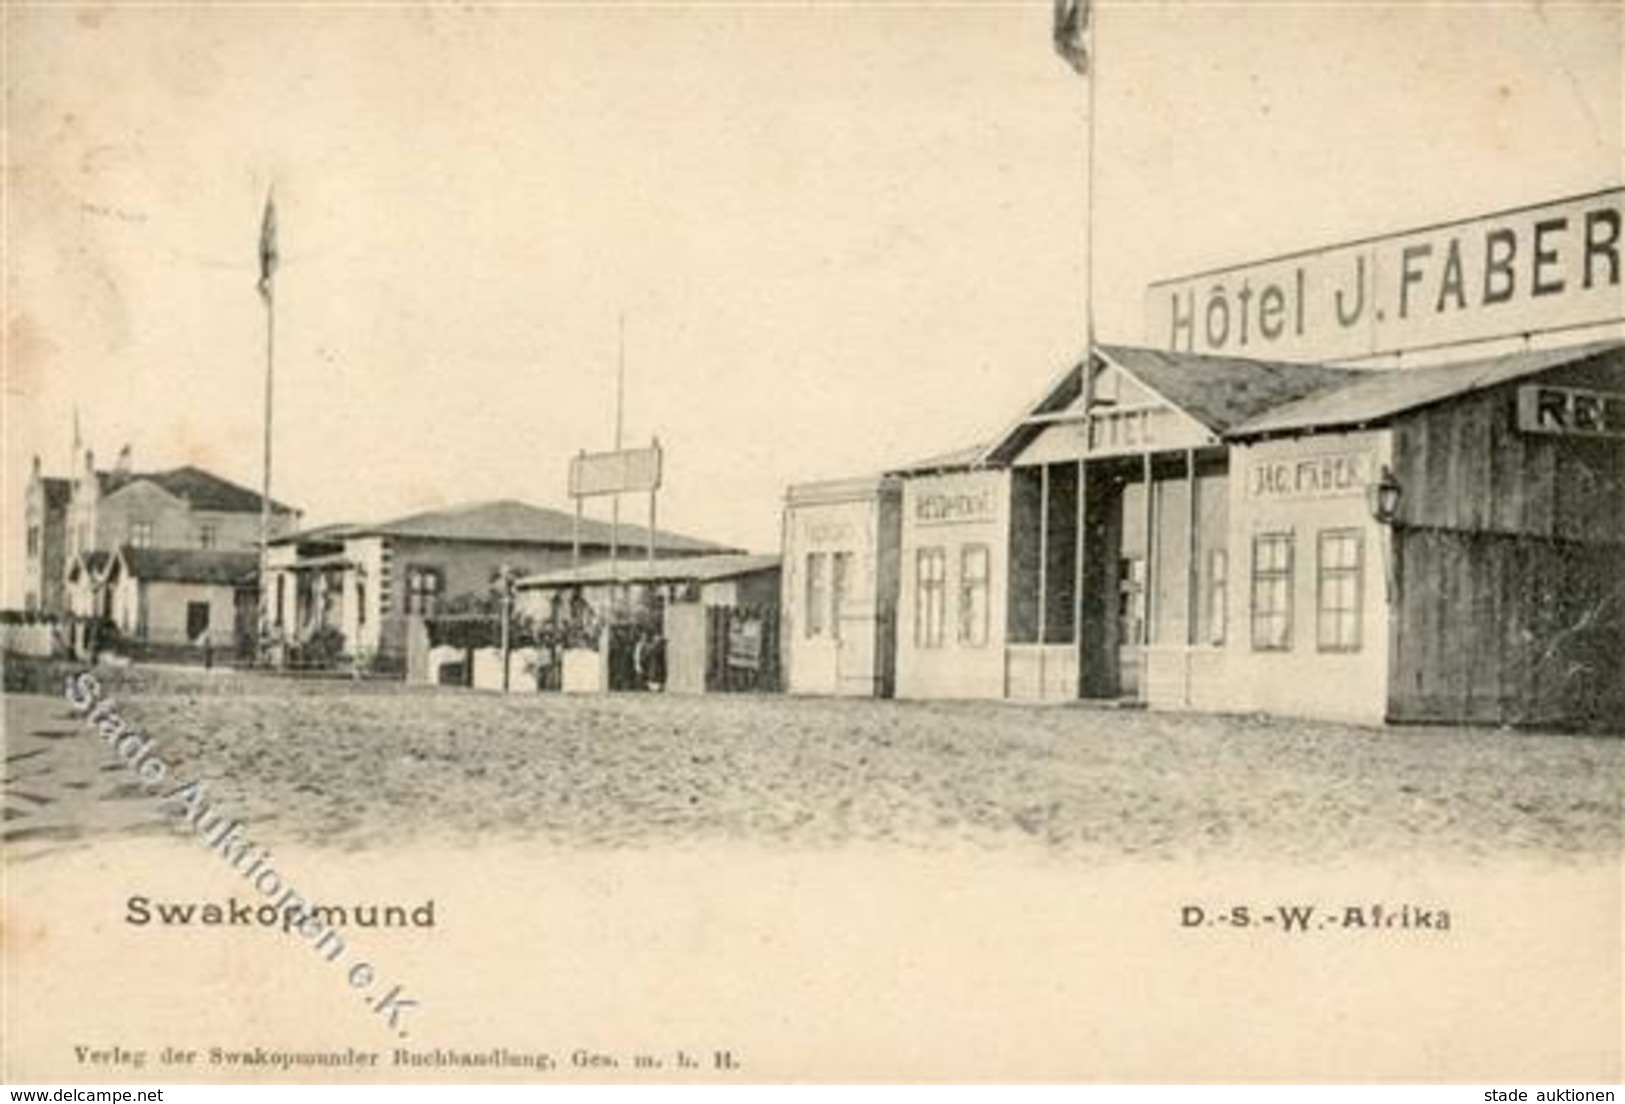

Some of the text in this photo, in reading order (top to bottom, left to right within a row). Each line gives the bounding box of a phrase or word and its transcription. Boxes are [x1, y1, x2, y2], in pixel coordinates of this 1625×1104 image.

[1170, 267, 1305, 349] Hôtel
[1400, 207, 1623, 318] FABER
[124, 896, 436, 932] Swakopmund
[74, 1045, 146, 1070] Verlag
[160, 1047, 198, 1065] der
[208, 1046, 380, 1071] Swakopmunder
